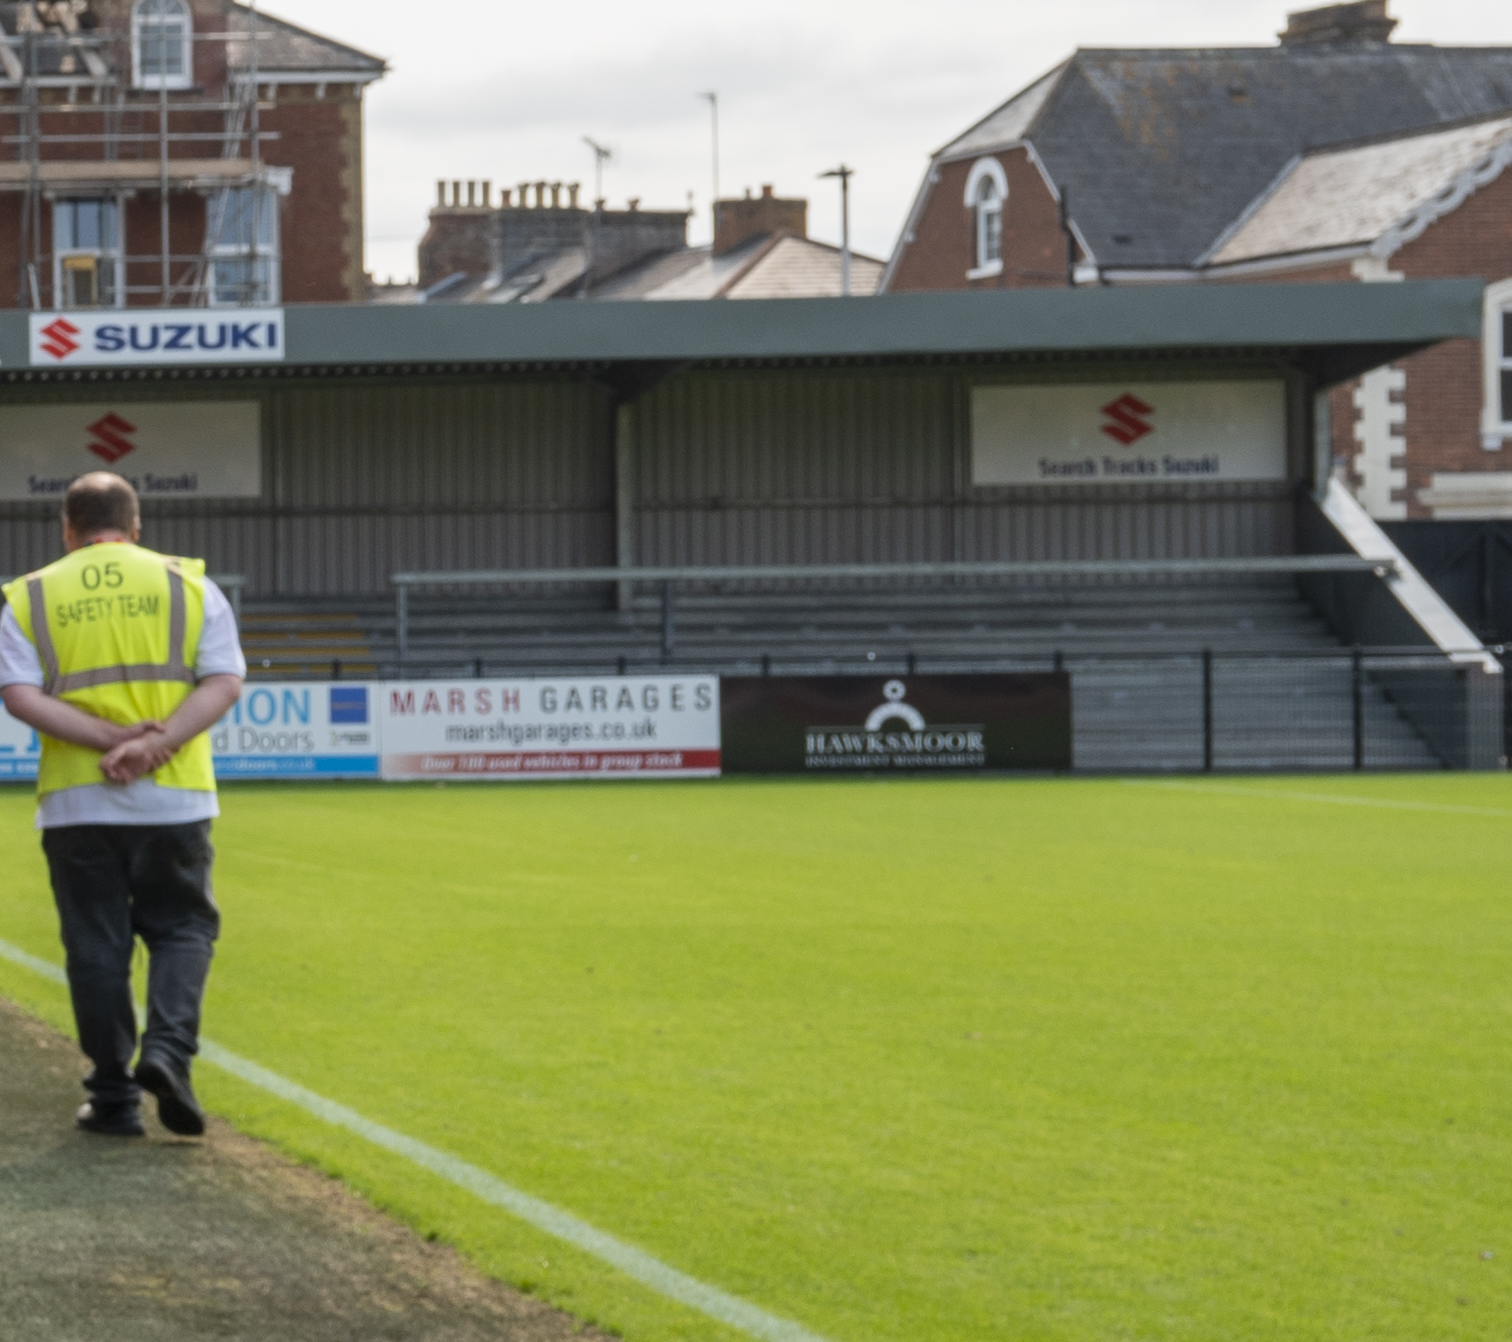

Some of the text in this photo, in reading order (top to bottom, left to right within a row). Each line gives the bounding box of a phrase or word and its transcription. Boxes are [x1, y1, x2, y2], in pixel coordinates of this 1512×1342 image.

[94, 321, 277, 352] SUZUKI
[1037, 455, 1221, 477] Search Tracks Suzuki
[144, 473, 198, 493] Suzuki
[81, 562, 124, 591] 05
[56, 594, 160, 628] SAFETY TEAM
[389, 682, 713, 716] MARSH GARAGES
[238, 726, 315, 755] Doors
[445, 716, 657, 746] marshgarages.co.uk
[805, 731, 985, 754] HAWKSMOOR
